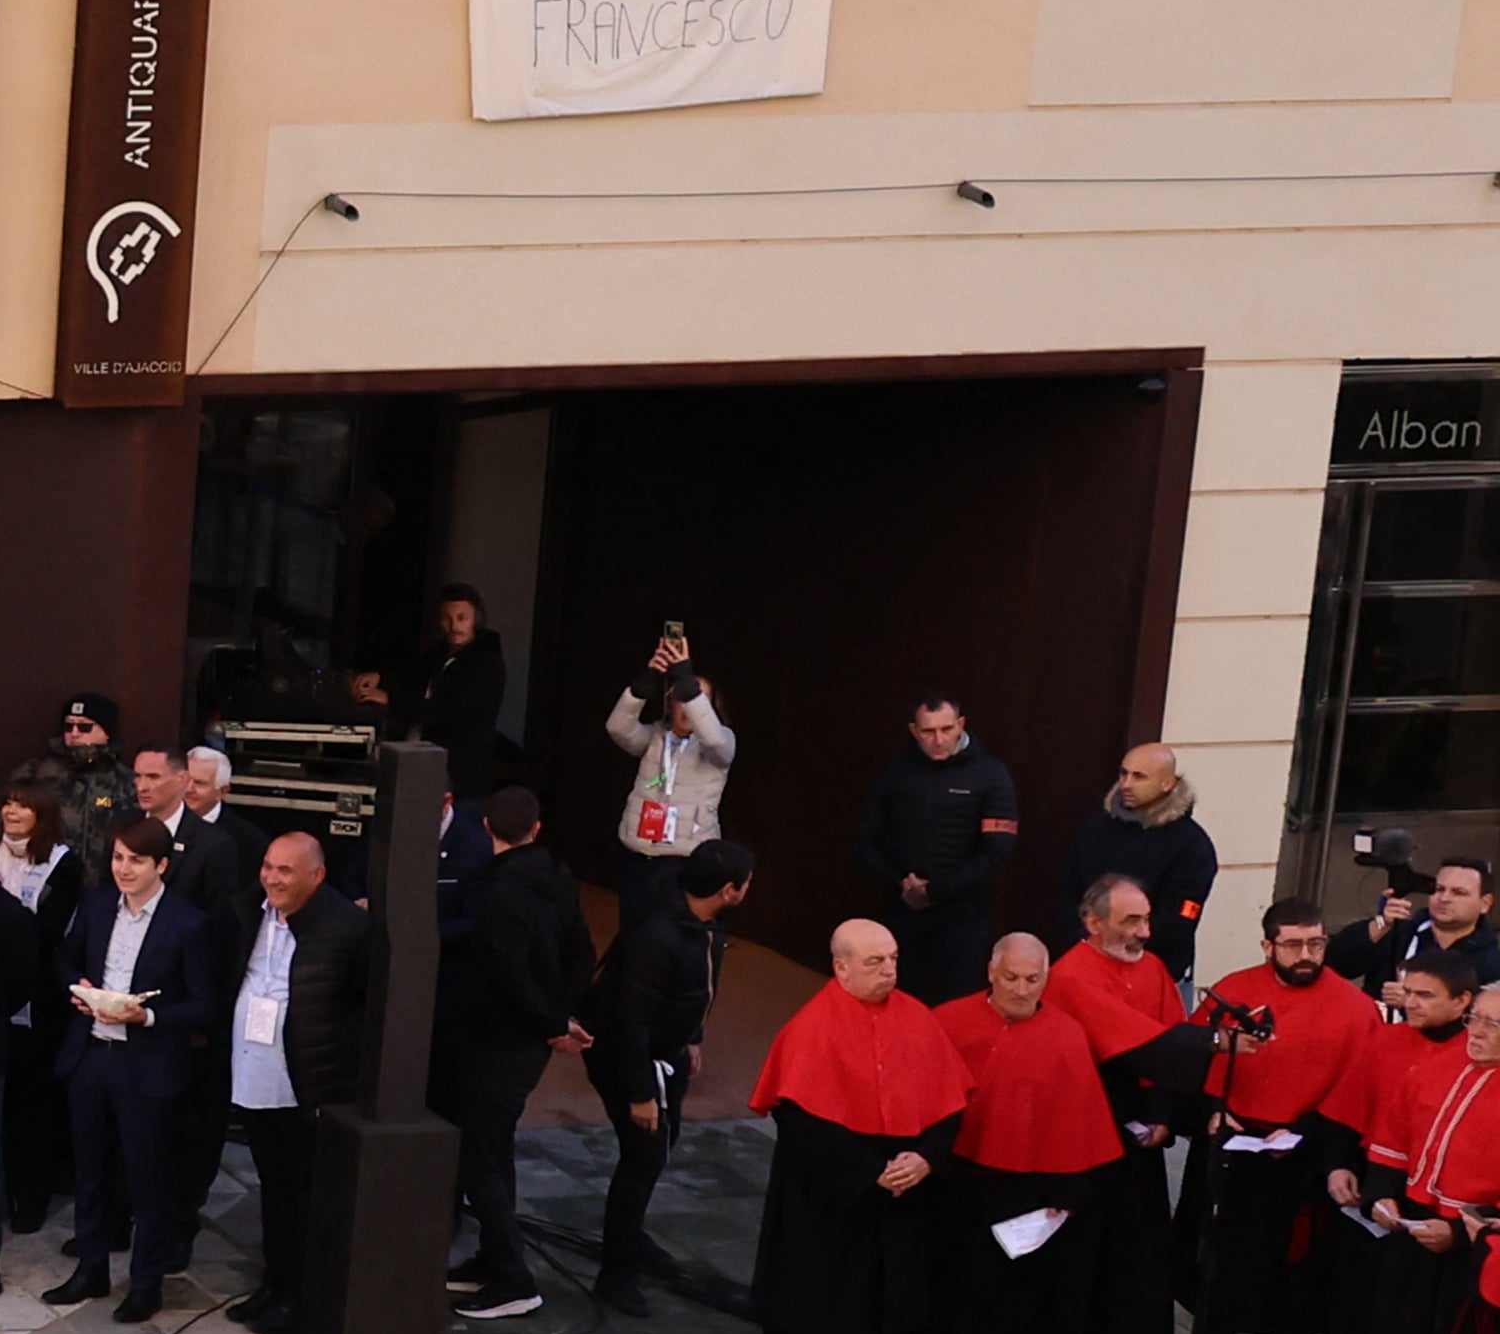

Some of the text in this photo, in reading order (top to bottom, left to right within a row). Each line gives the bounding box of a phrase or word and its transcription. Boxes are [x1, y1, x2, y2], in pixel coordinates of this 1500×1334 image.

[73, 360, 183, 375] VILLE D'AJACCIO
[1358, 410, 1482, 449] Alban
